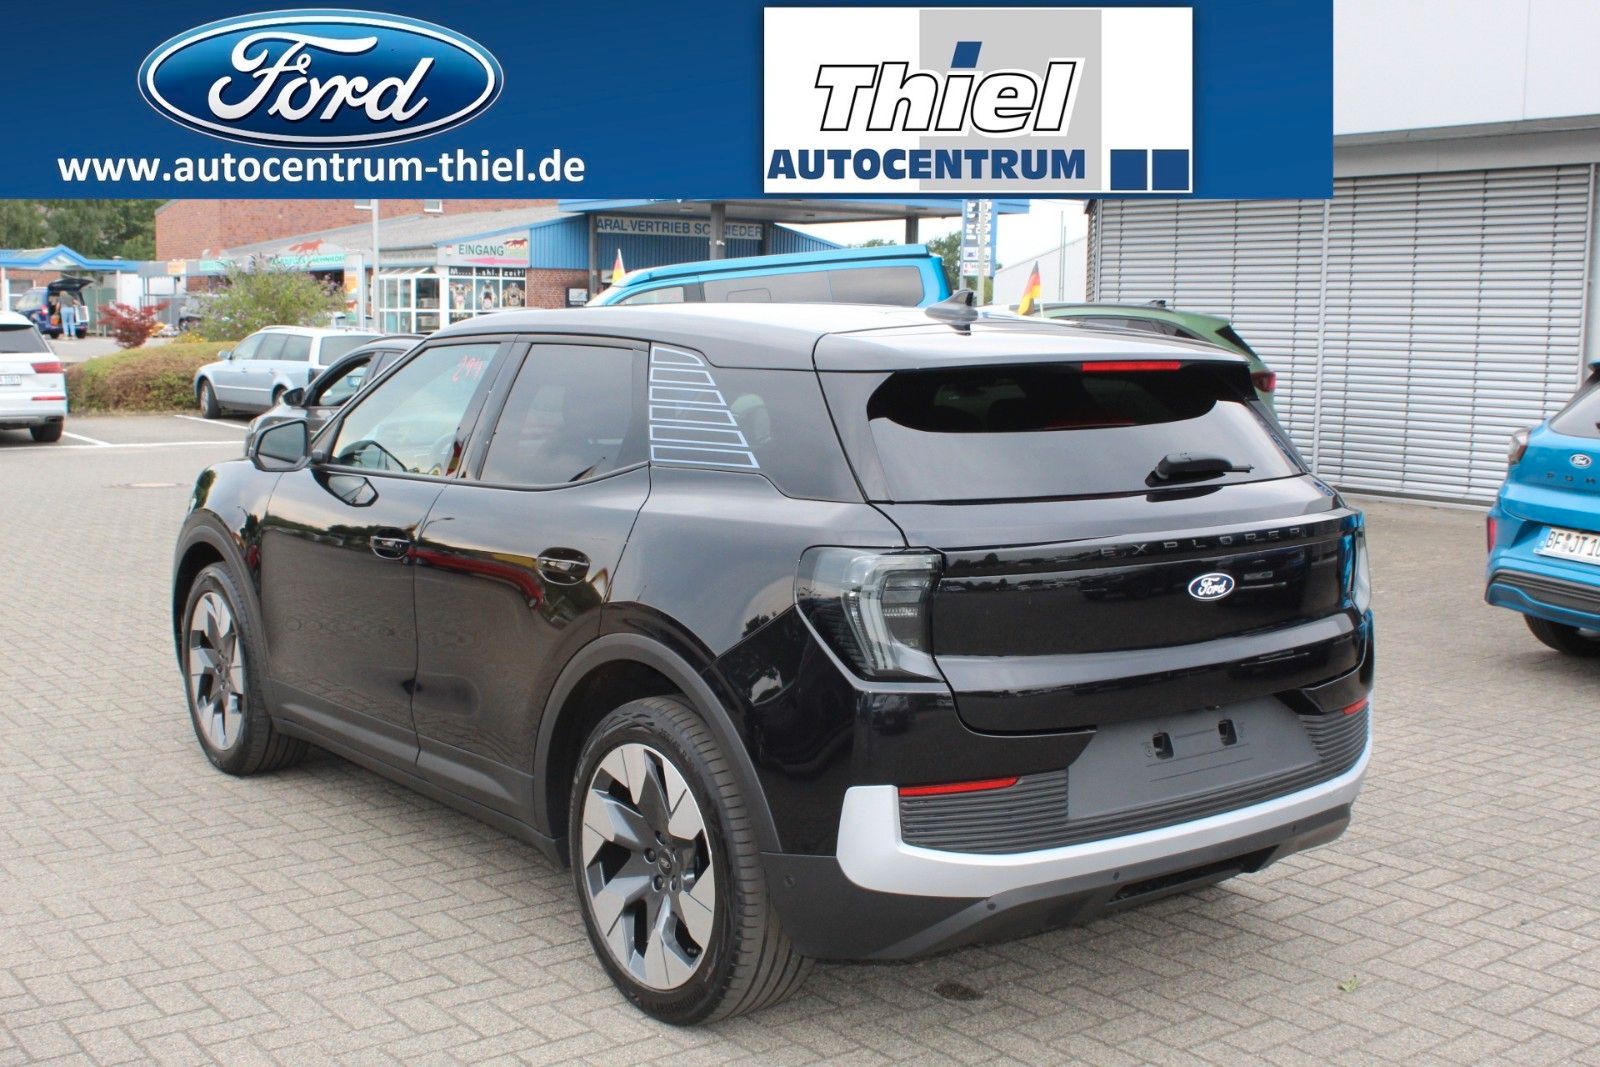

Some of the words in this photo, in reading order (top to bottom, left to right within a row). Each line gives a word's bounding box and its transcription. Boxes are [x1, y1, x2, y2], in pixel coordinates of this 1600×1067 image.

[458, 244, 504, 256] EINGANG
[1100, 527, 1307, 557] EXPLORER
[1197, 577, 1227, 596] Ford
